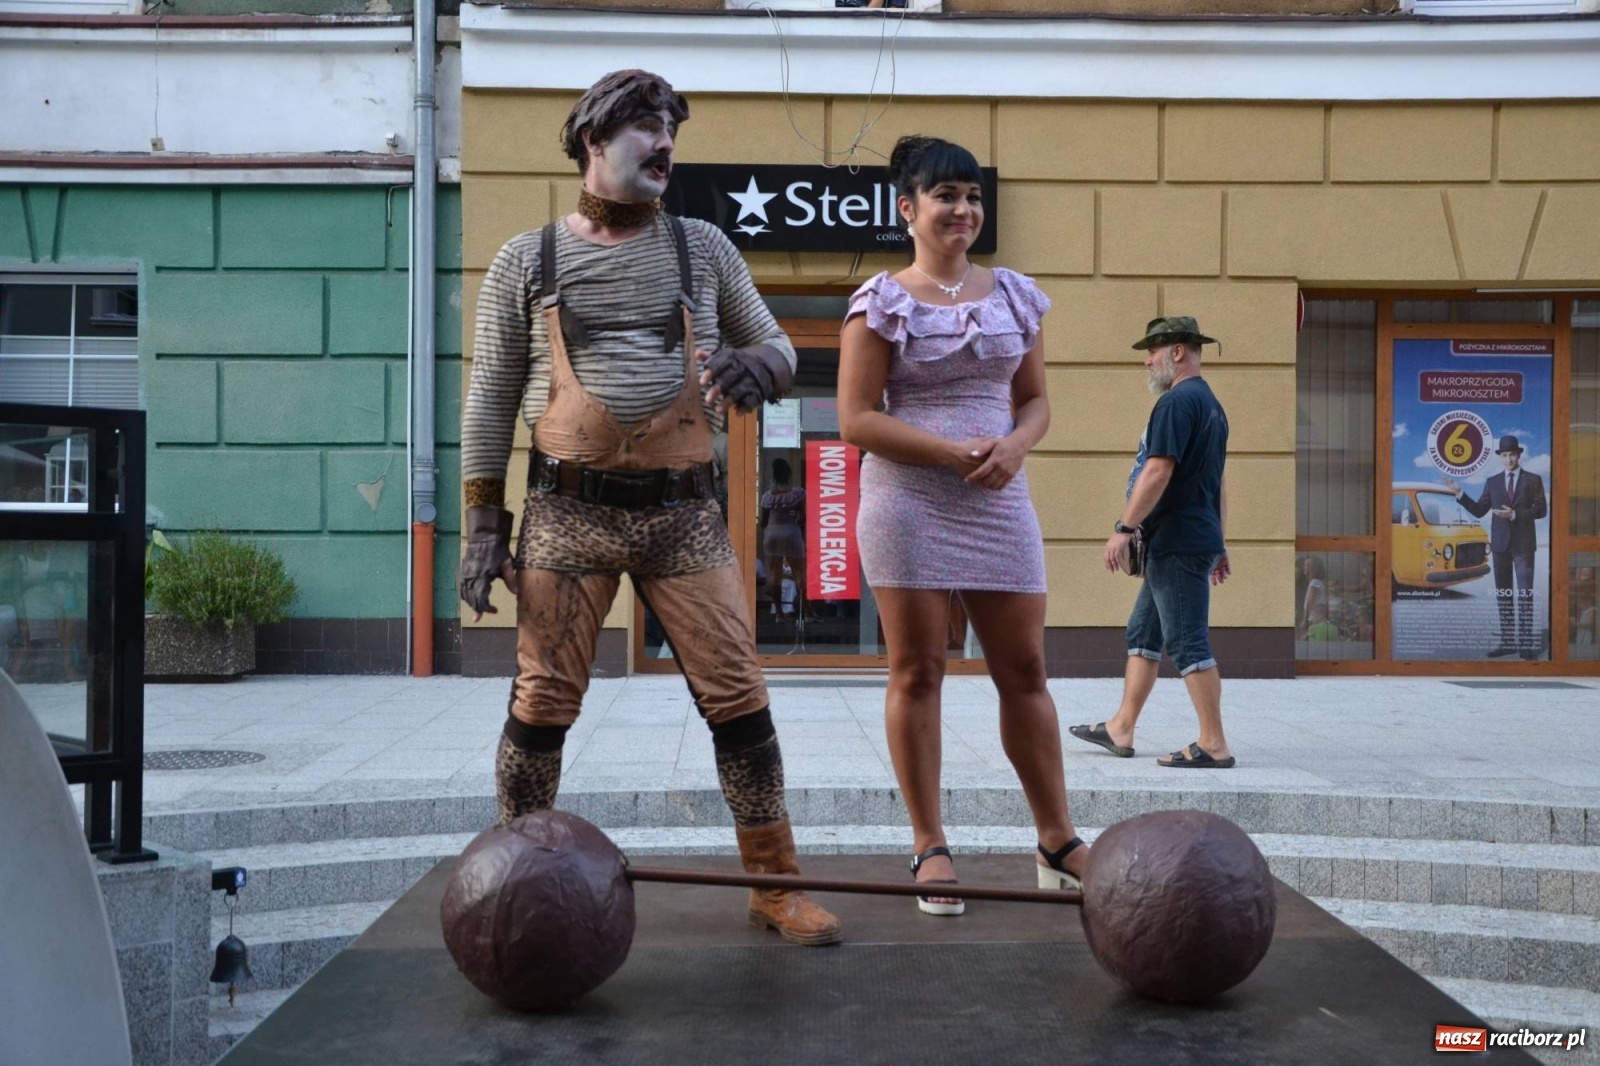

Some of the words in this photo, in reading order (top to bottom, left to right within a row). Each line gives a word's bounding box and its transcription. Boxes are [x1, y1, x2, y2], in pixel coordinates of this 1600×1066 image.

[785, 181, 898, 227] Stell
[876, 232, 907, 241] collez
[1427, 377, 1515, 387] MAKROPRZYGODA
[1432, 388, 1509, 399] MIKROKOSZTEM
[1444, 423, 1473, 464] 6
[819, 446, 847, 498] NOWA
[819, 503, 847, 595] KOLEKCJA
[1487, 588, 1513, 597] RRSO
